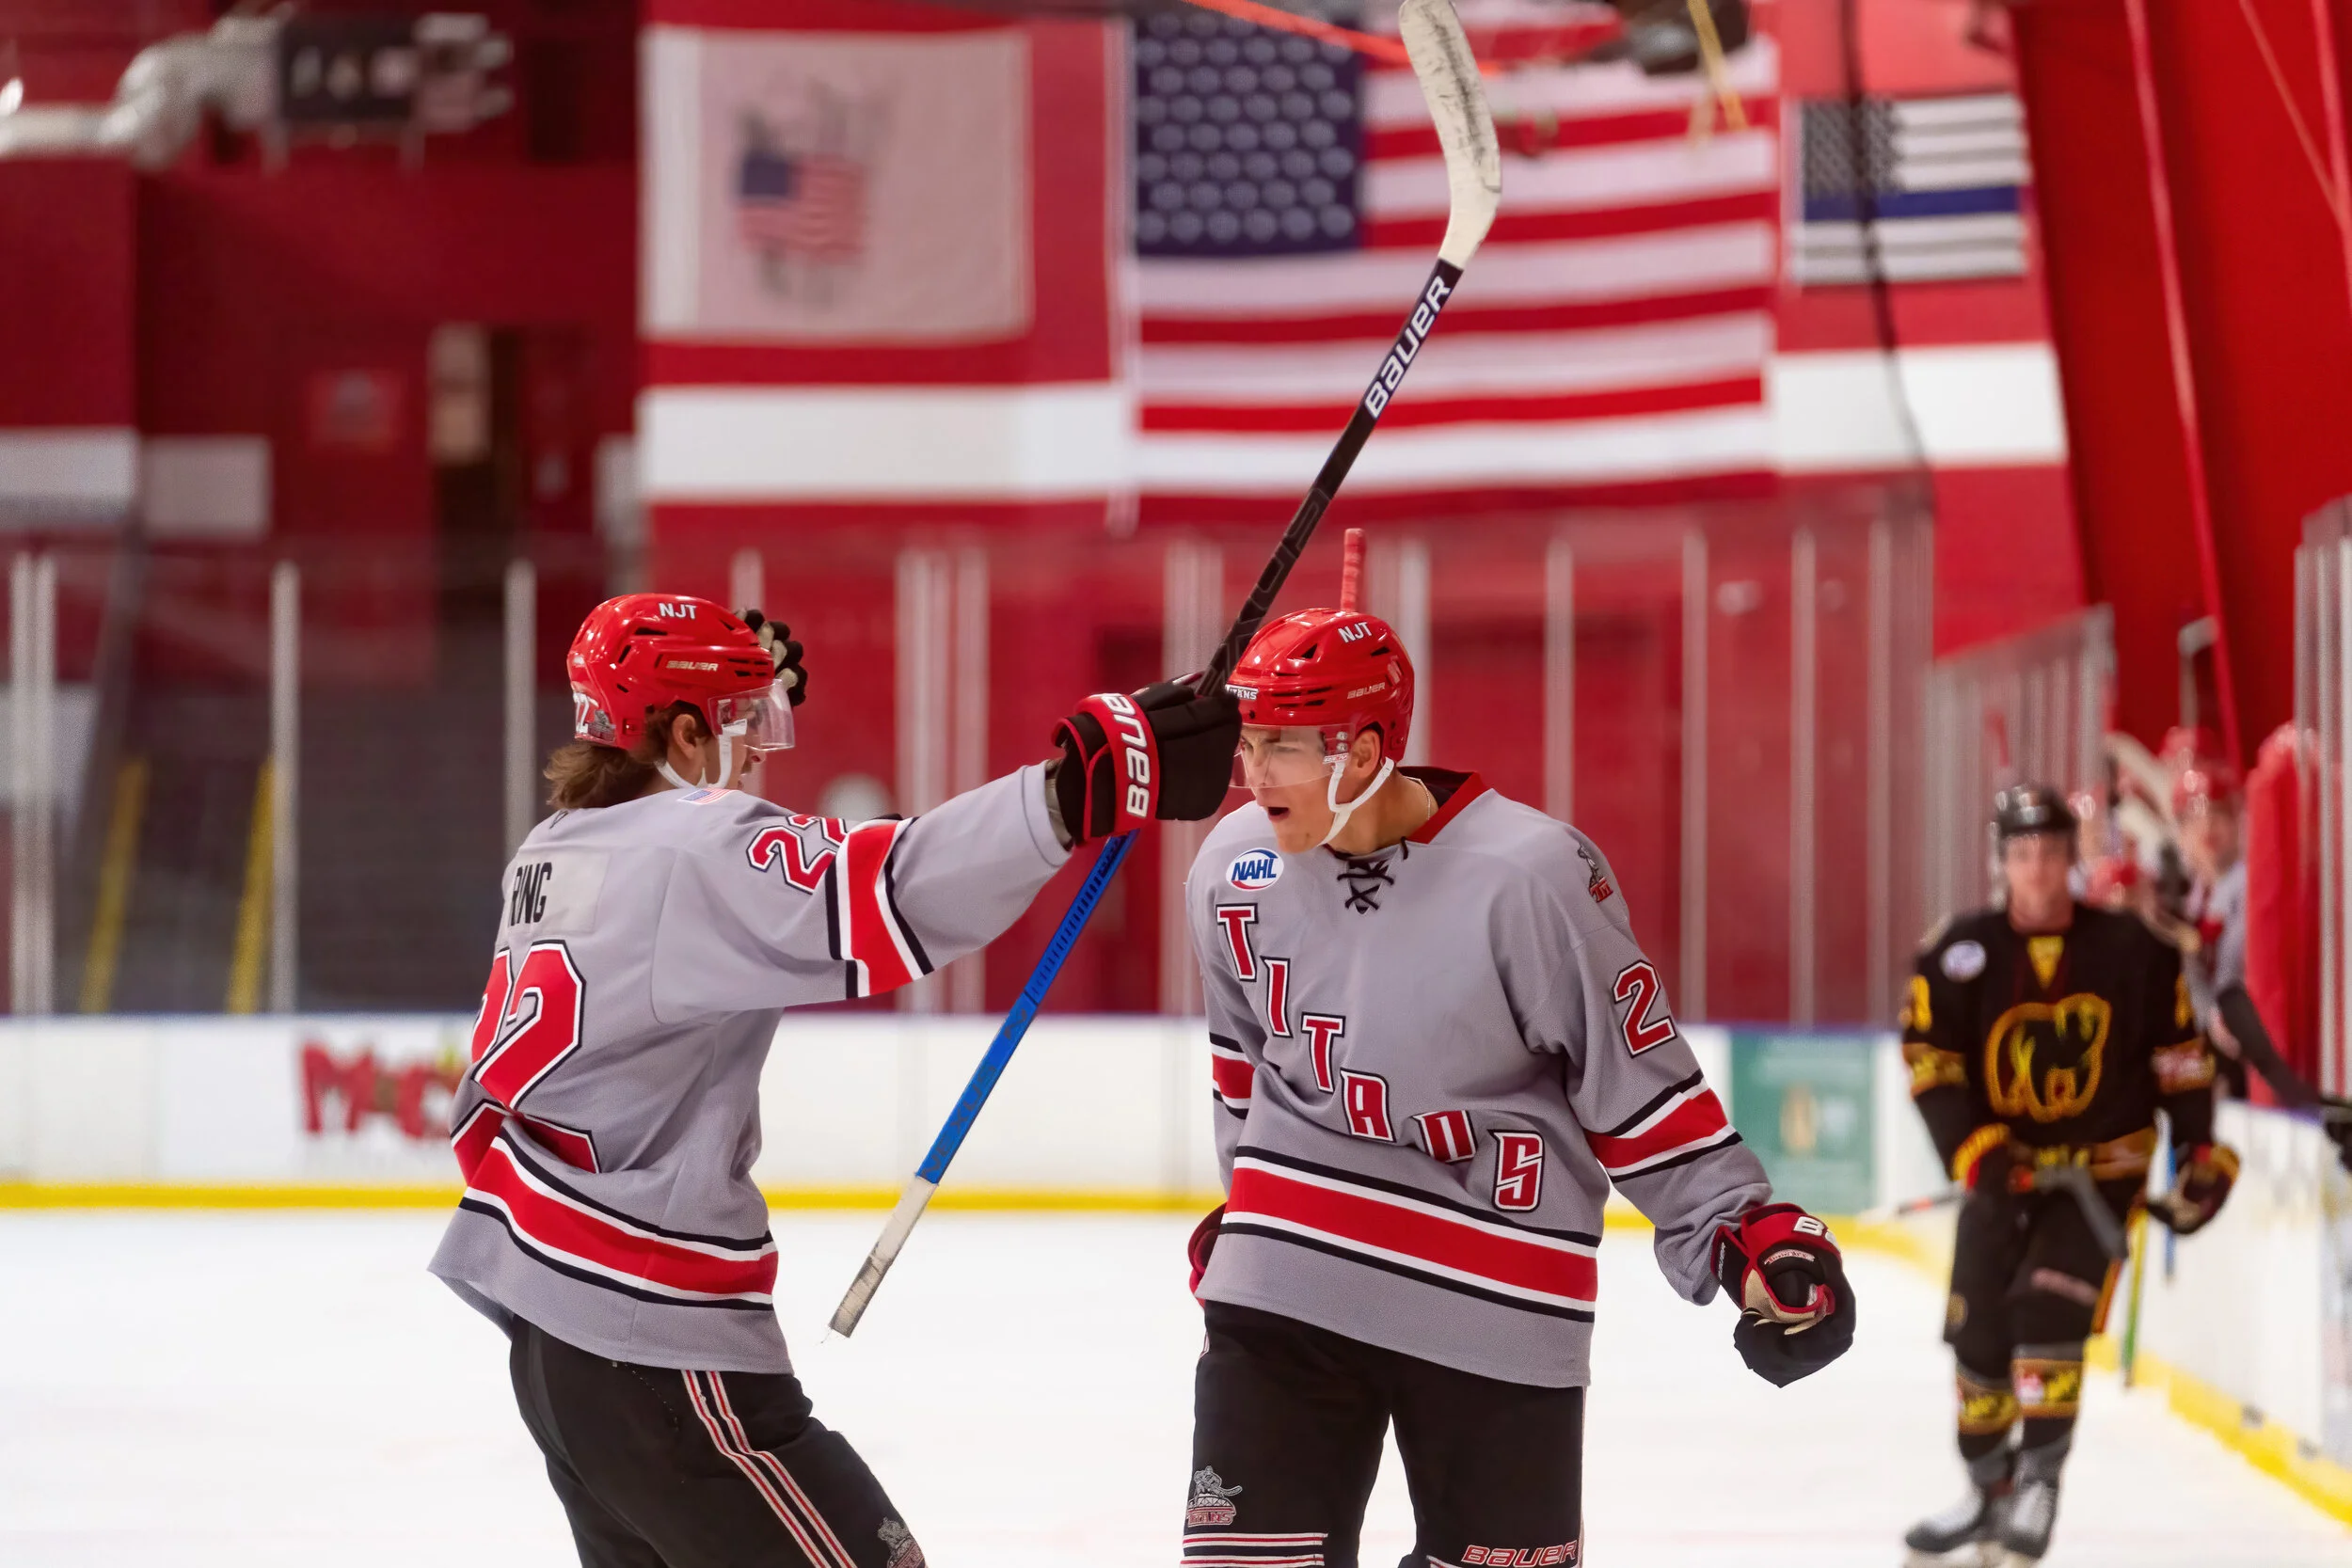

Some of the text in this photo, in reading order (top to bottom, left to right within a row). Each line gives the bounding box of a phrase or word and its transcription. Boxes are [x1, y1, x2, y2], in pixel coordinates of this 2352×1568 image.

[1365, 276, 1451, 420] BAUER
[659, 602, 697, 620] NJT
[1338, 622, 1373, 643] NJT
[1231, 859, 1277, 881] NAHL
[1612, 959, 1677, 1058] 2
[1216, 902, 1546, 1212] TITANS
[1461, 1539, 1578, 1568] BAUER
